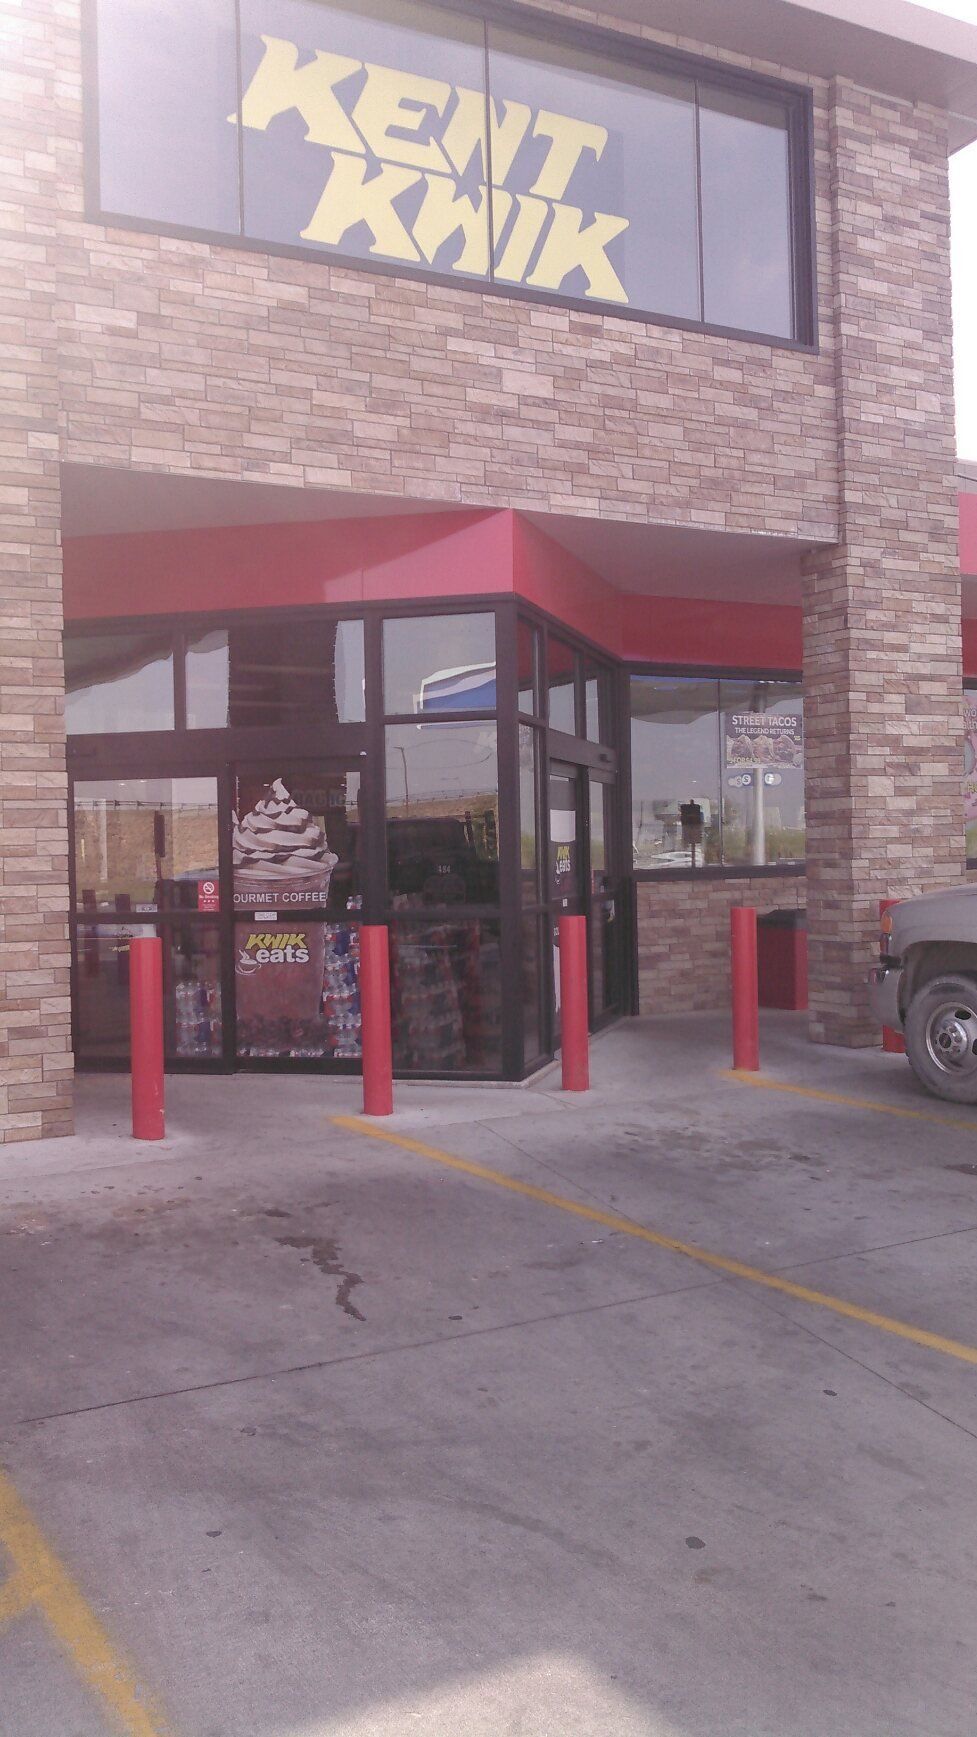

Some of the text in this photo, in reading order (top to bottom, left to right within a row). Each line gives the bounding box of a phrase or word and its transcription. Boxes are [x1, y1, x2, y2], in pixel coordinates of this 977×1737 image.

[226, 34, 609, 202] KENT
[300, 151, 631, 303] KWIK
[732, 715, 797, 727] STREET TACOS
[747, 727, 769, 735] LEGEND
[282, 892, 327, 902] COFFEE
[245, 933, 307, 949] KWIK
[256, 945, 310, 963] eats
